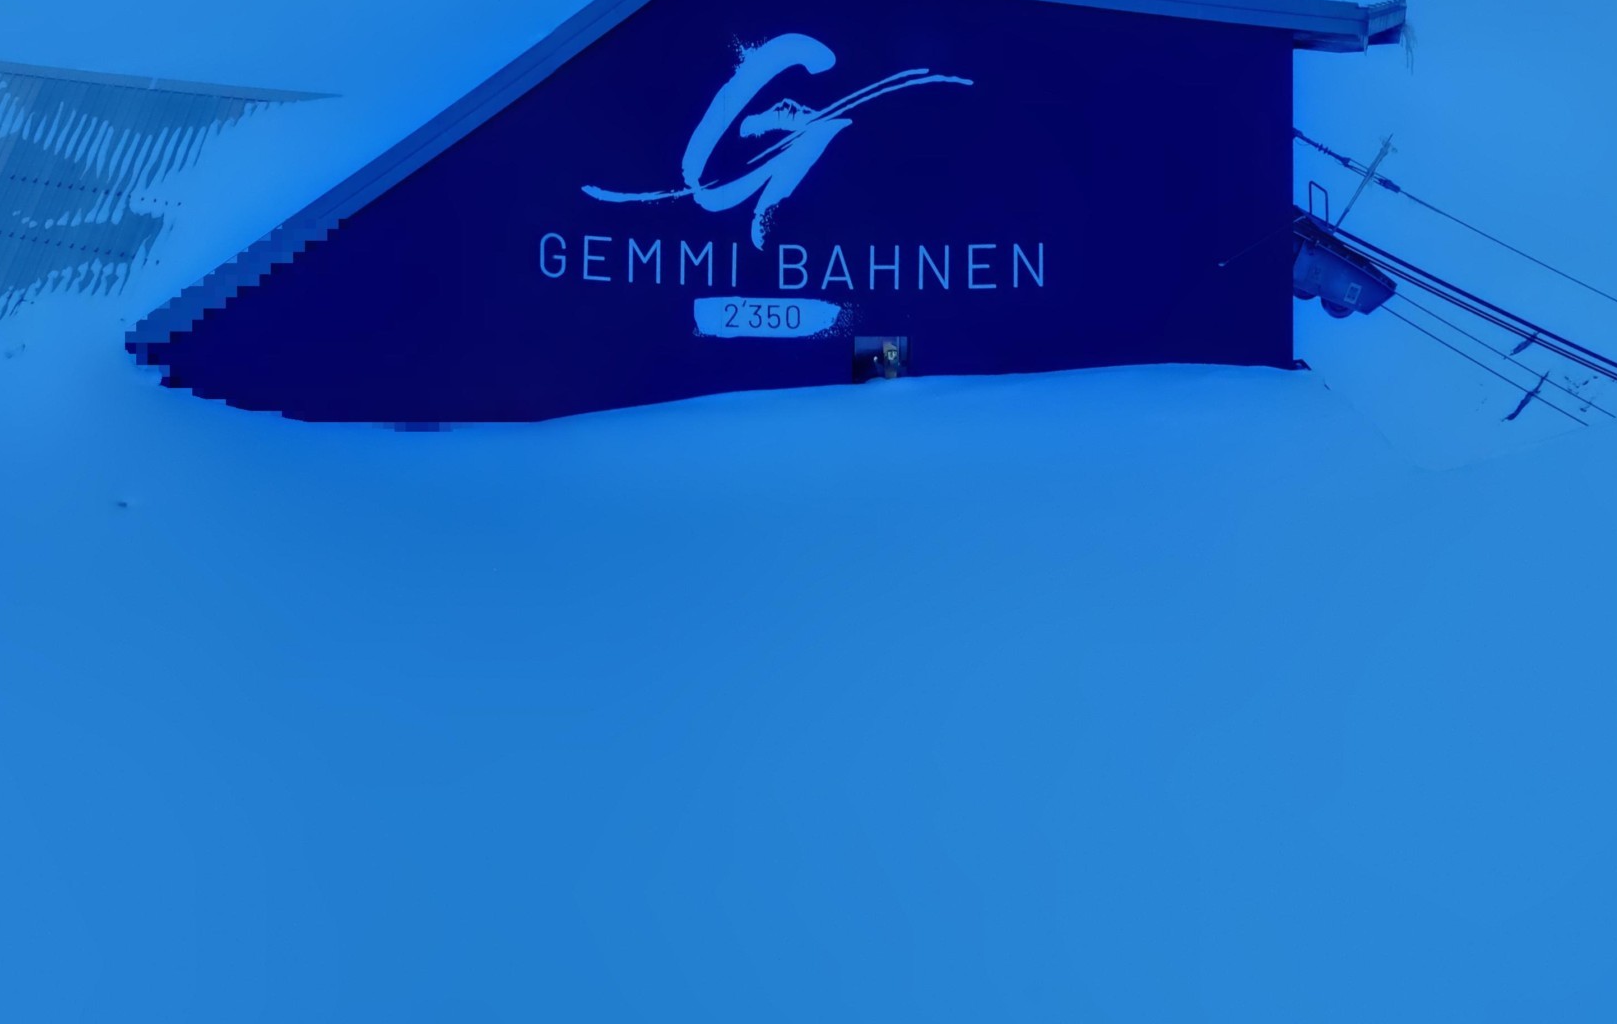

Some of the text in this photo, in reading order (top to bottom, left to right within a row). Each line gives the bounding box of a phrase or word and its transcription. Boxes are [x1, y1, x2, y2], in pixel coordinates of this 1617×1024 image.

[539, 232, 1045, 291] GEMMI BAHNEN
[724, 299, 802, 330] 2'350
